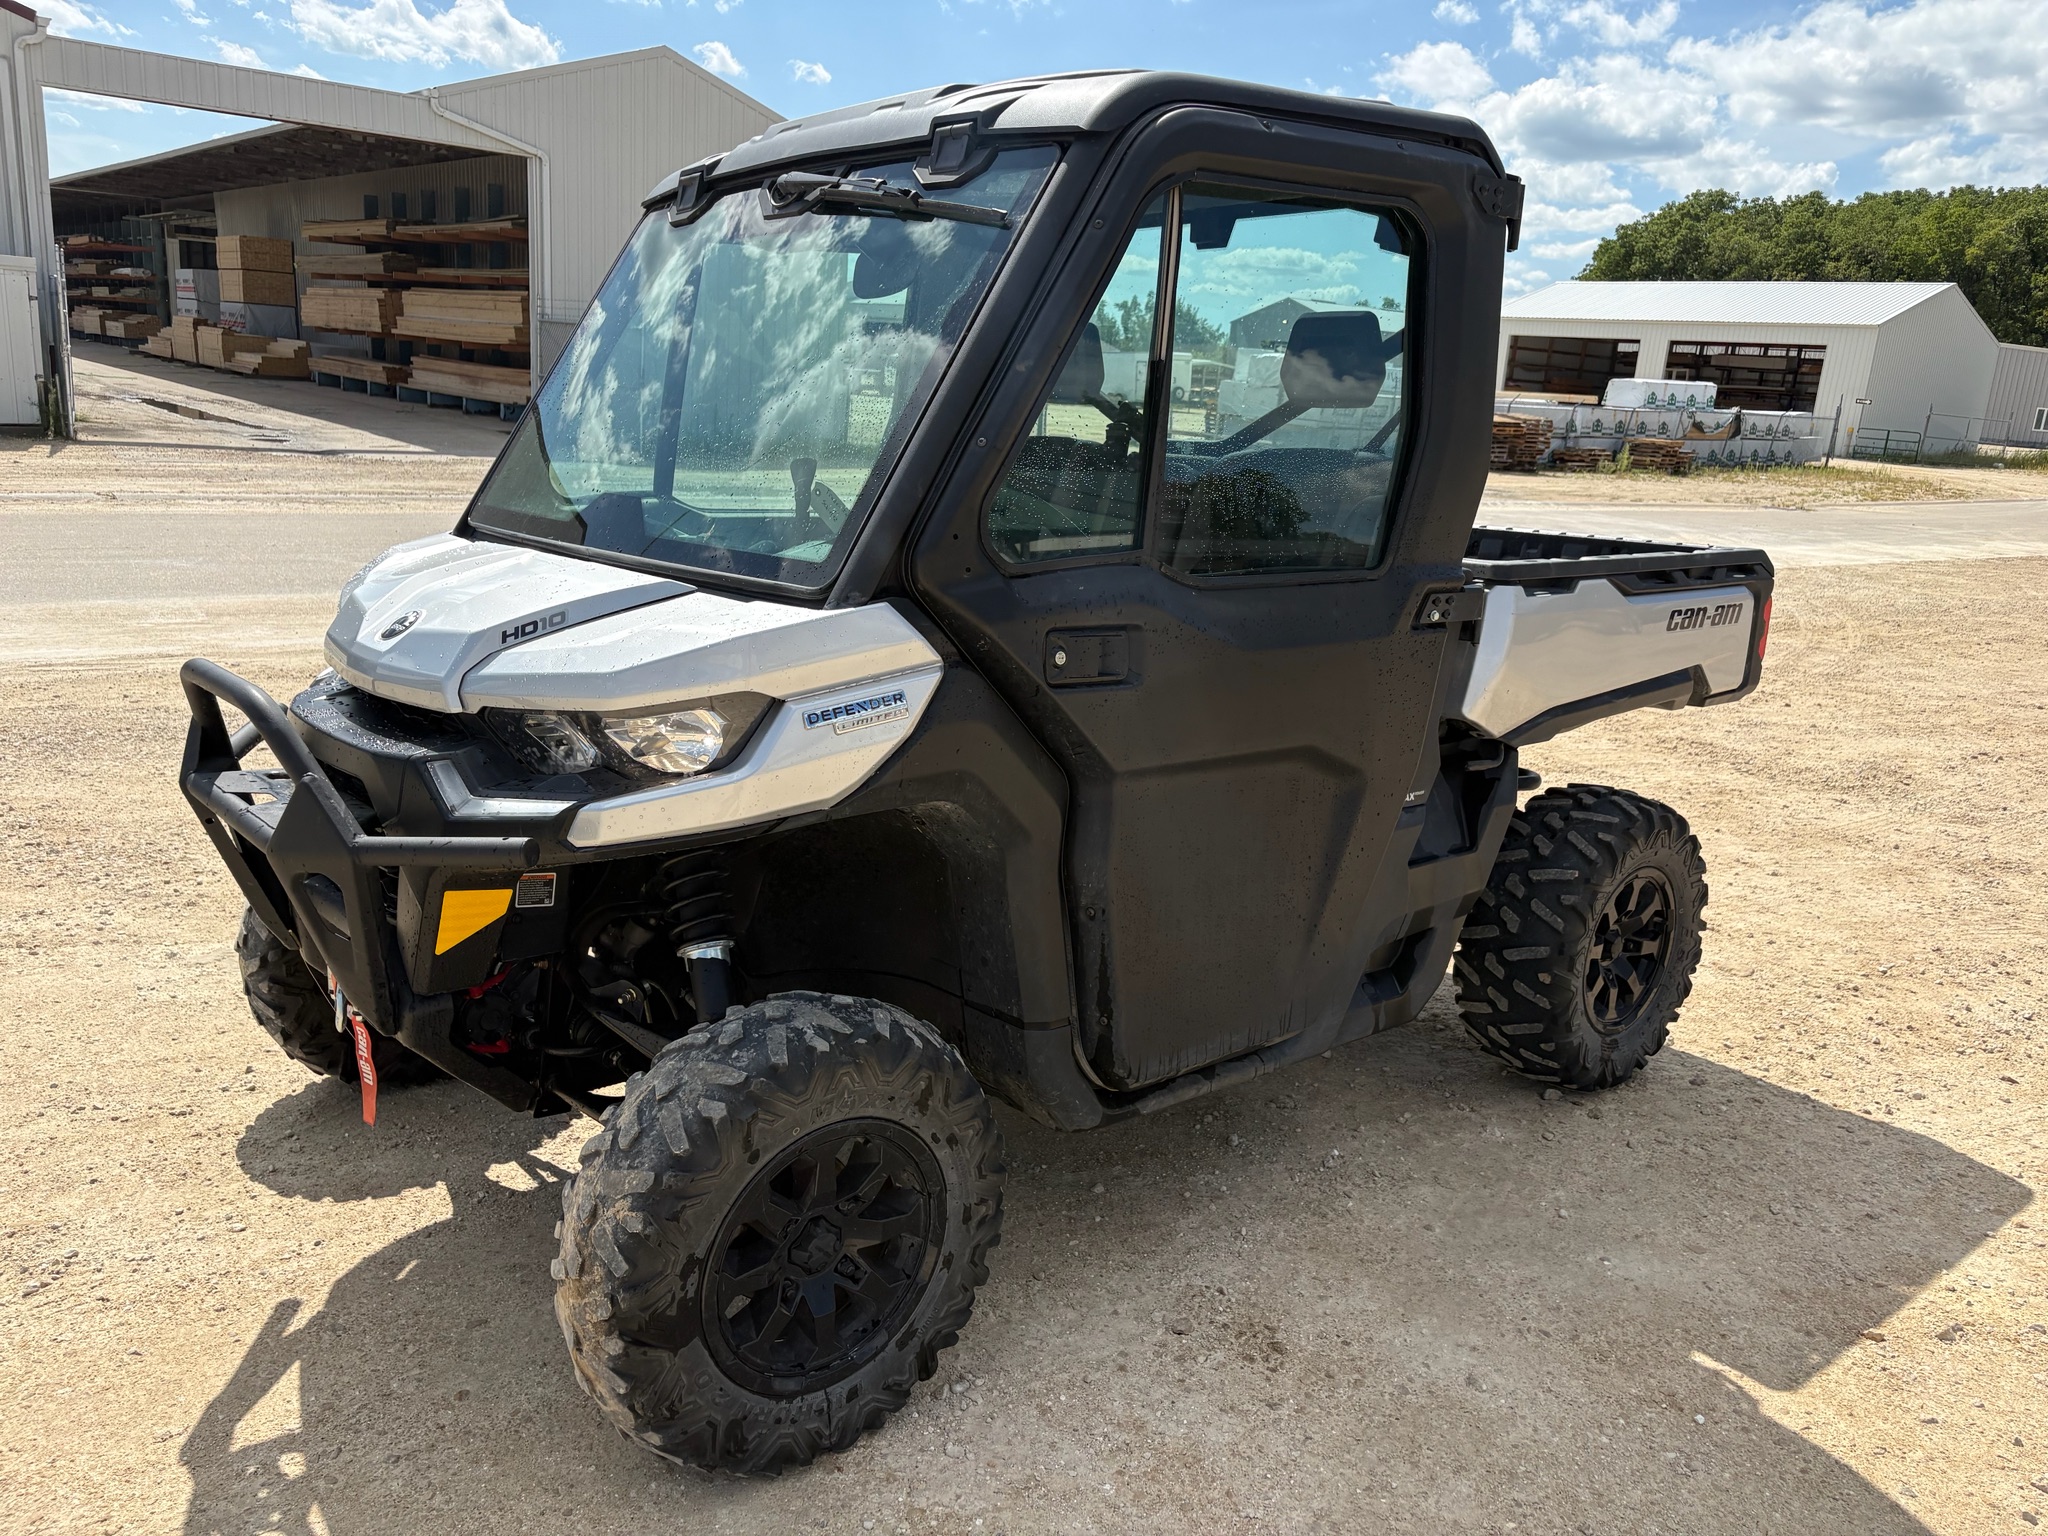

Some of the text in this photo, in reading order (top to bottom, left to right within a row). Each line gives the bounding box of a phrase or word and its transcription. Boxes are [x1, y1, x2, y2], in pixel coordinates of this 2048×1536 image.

[501, 610, 566, 644] HD10
[1666, 602, 1743, 632] can-am
[807, 693, 904, 725] DEFENDER
[355, 1025, 374, 1086] can-am
